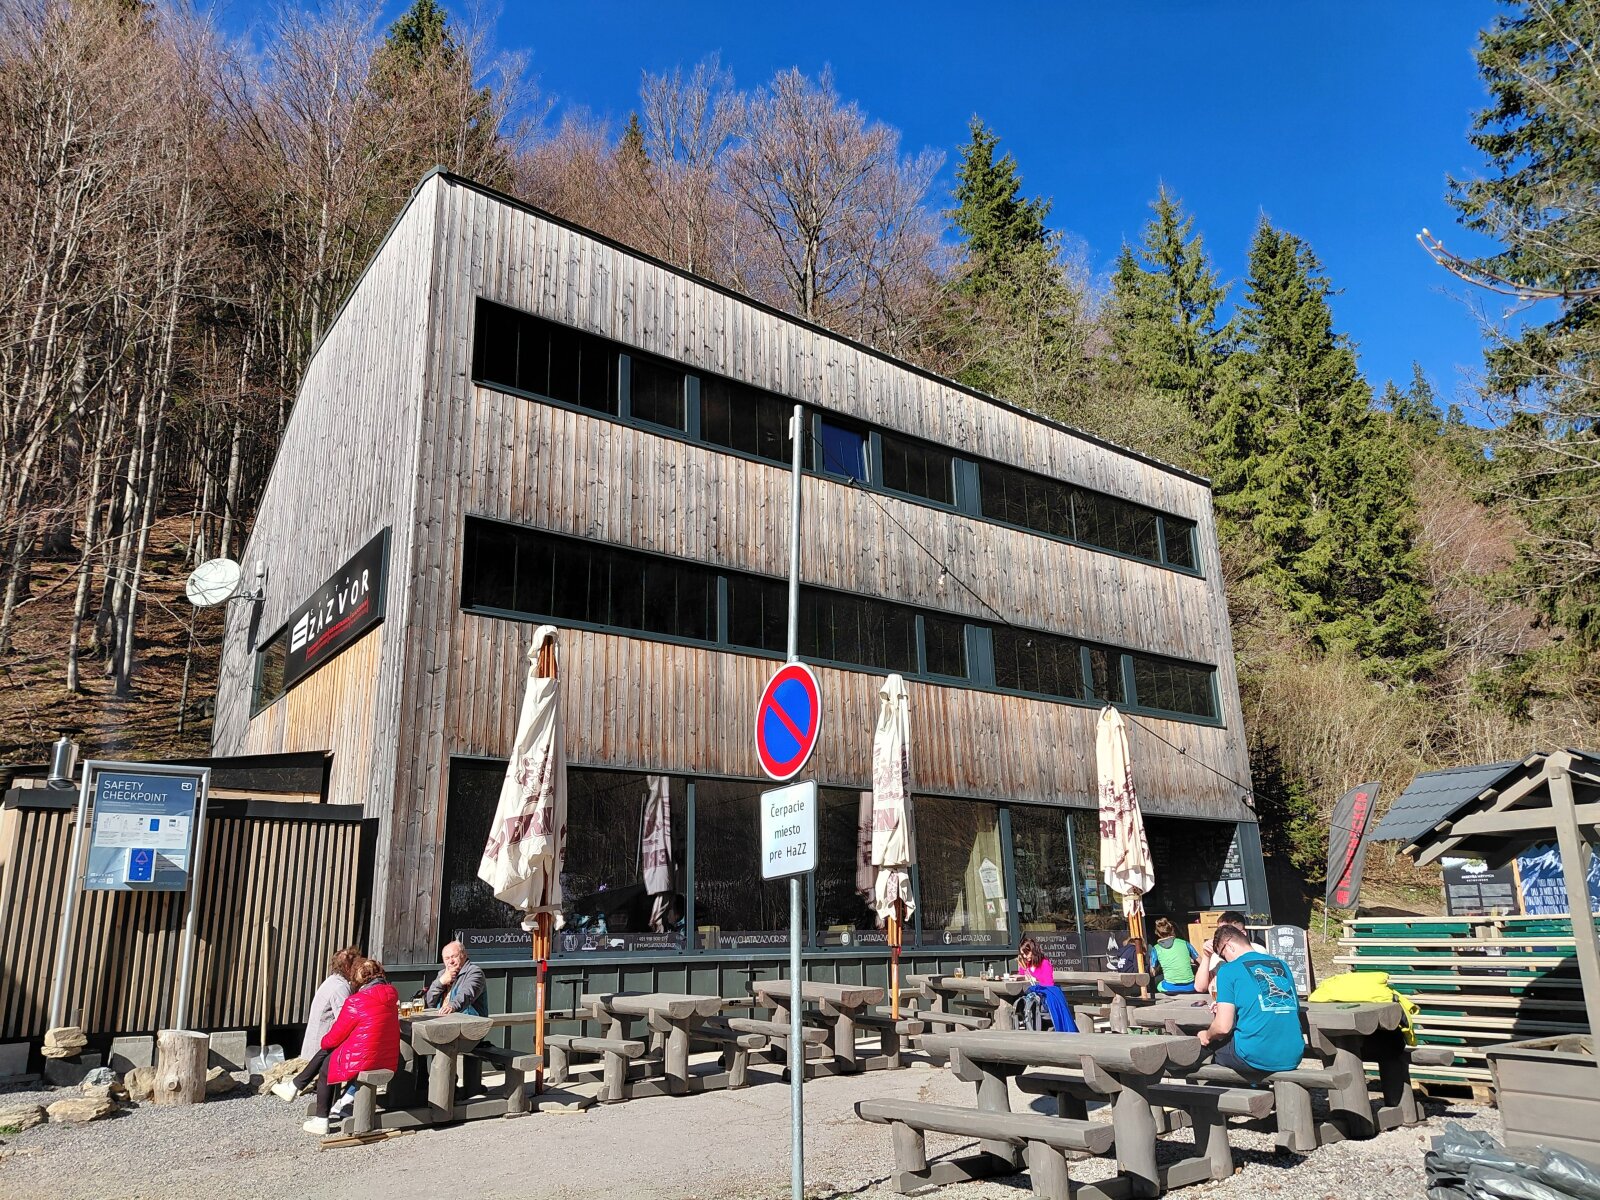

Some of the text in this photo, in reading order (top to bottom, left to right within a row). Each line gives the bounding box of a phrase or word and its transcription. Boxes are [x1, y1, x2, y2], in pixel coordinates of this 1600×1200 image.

[103, 780, 144, 791] SAFETY
[102, 790, 168, 802] CHECKPOINT
[770, 800, 805, 818] Čerpacie
[774, 824, 801, 840] miesto
[769, 842, 807, 863] pre HaZZ
